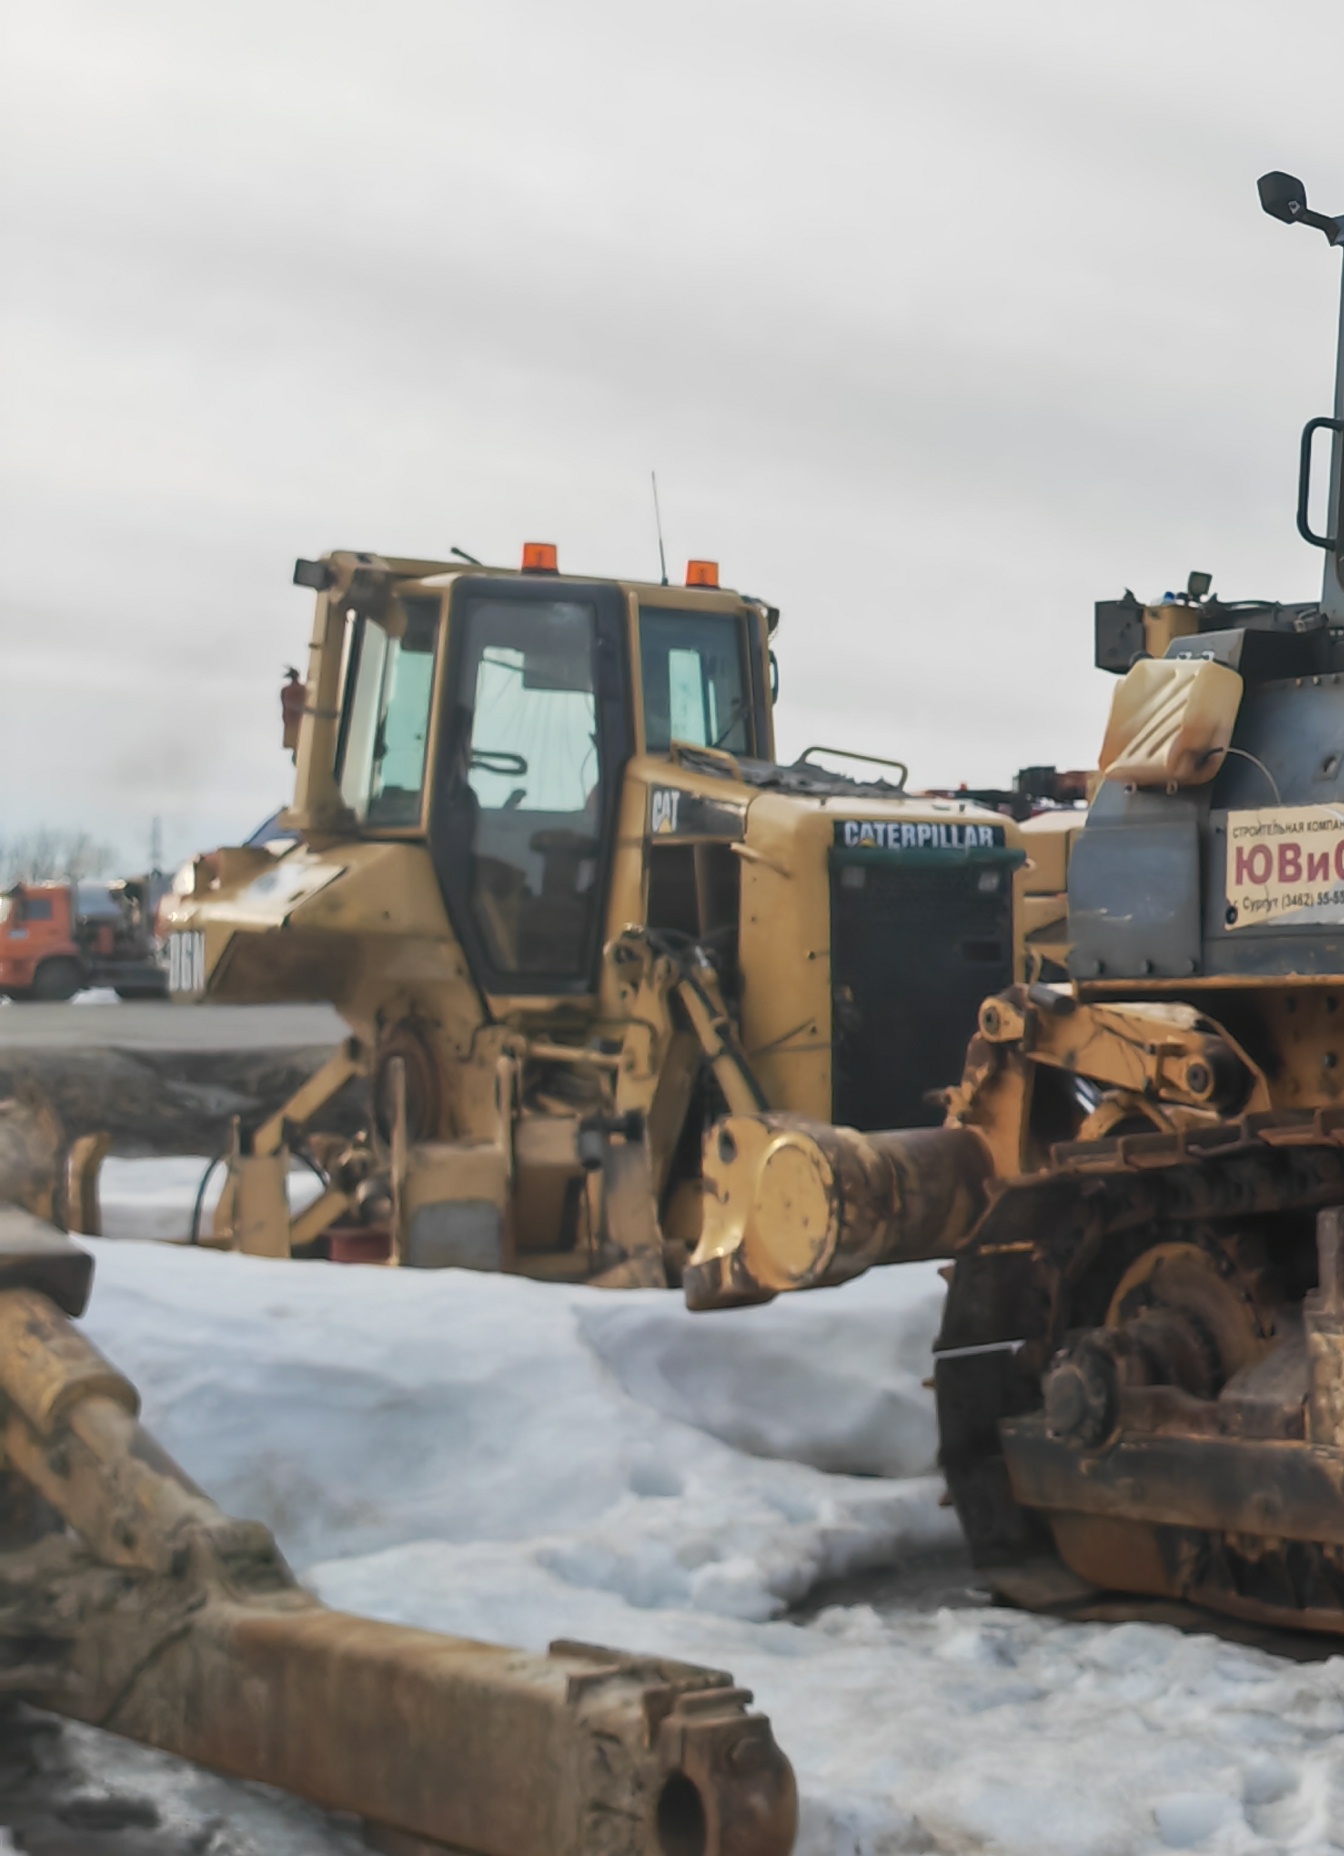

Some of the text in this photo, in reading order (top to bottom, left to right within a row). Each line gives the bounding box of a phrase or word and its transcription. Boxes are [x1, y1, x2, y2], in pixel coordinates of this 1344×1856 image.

[652, 789, 680, 833] CAT
[844, 820, 994, 849] CATERPILLAR
[1232, 821, 1304, 838] СТРОИТЕЛЬНАЯ
